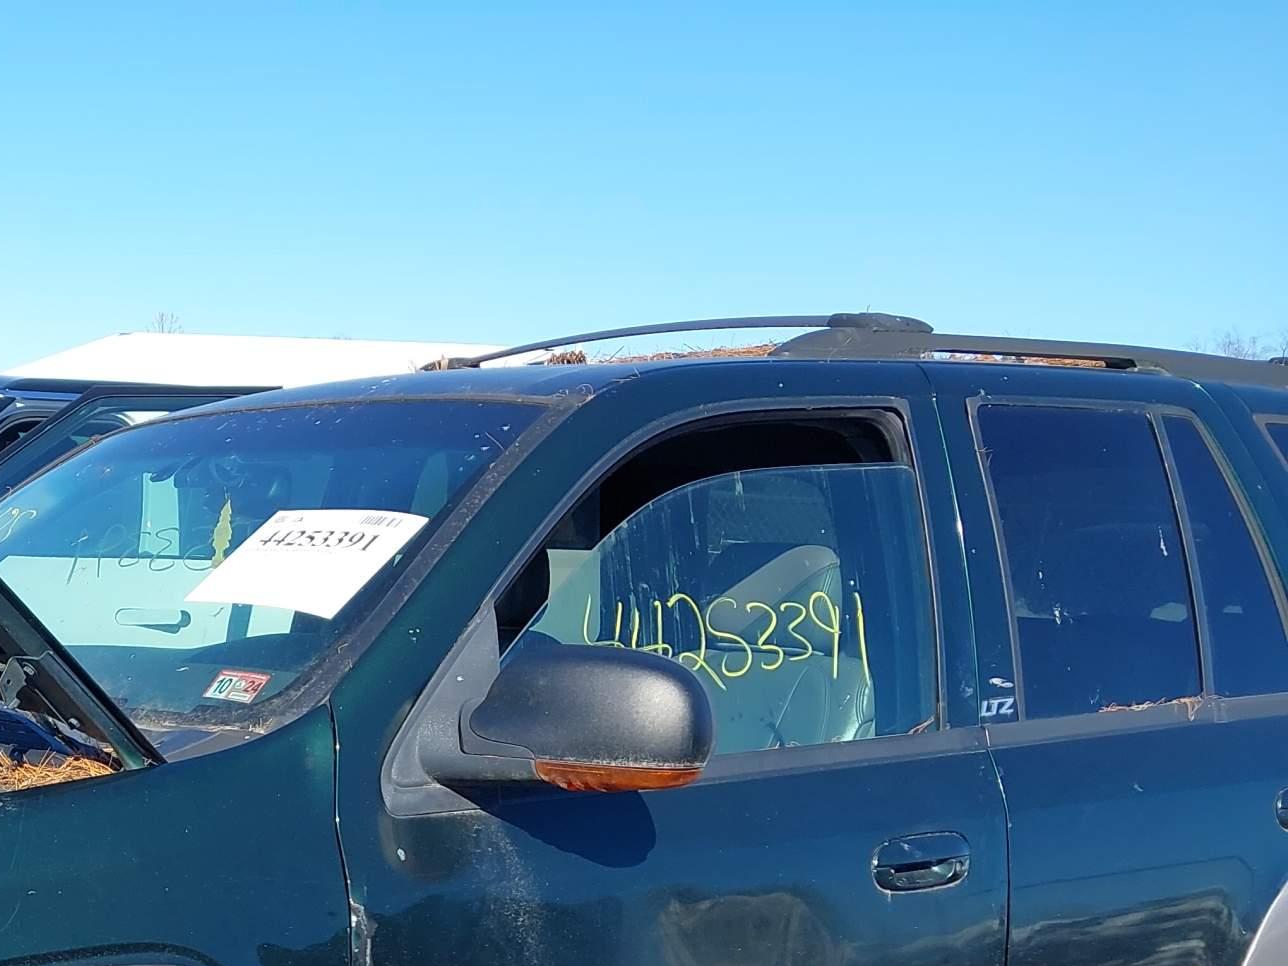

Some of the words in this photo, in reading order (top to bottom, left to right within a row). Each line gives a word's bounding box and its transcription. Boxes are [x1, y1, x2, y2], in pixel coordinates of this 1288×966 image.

[259, 529, 380, 551] 44253391
[582, 591, 871, 690] 44253391
[213, 678, 233, 694] 10
[243, 681, 263, 693] 24
[980, 697, 1014, 717] LTZ
